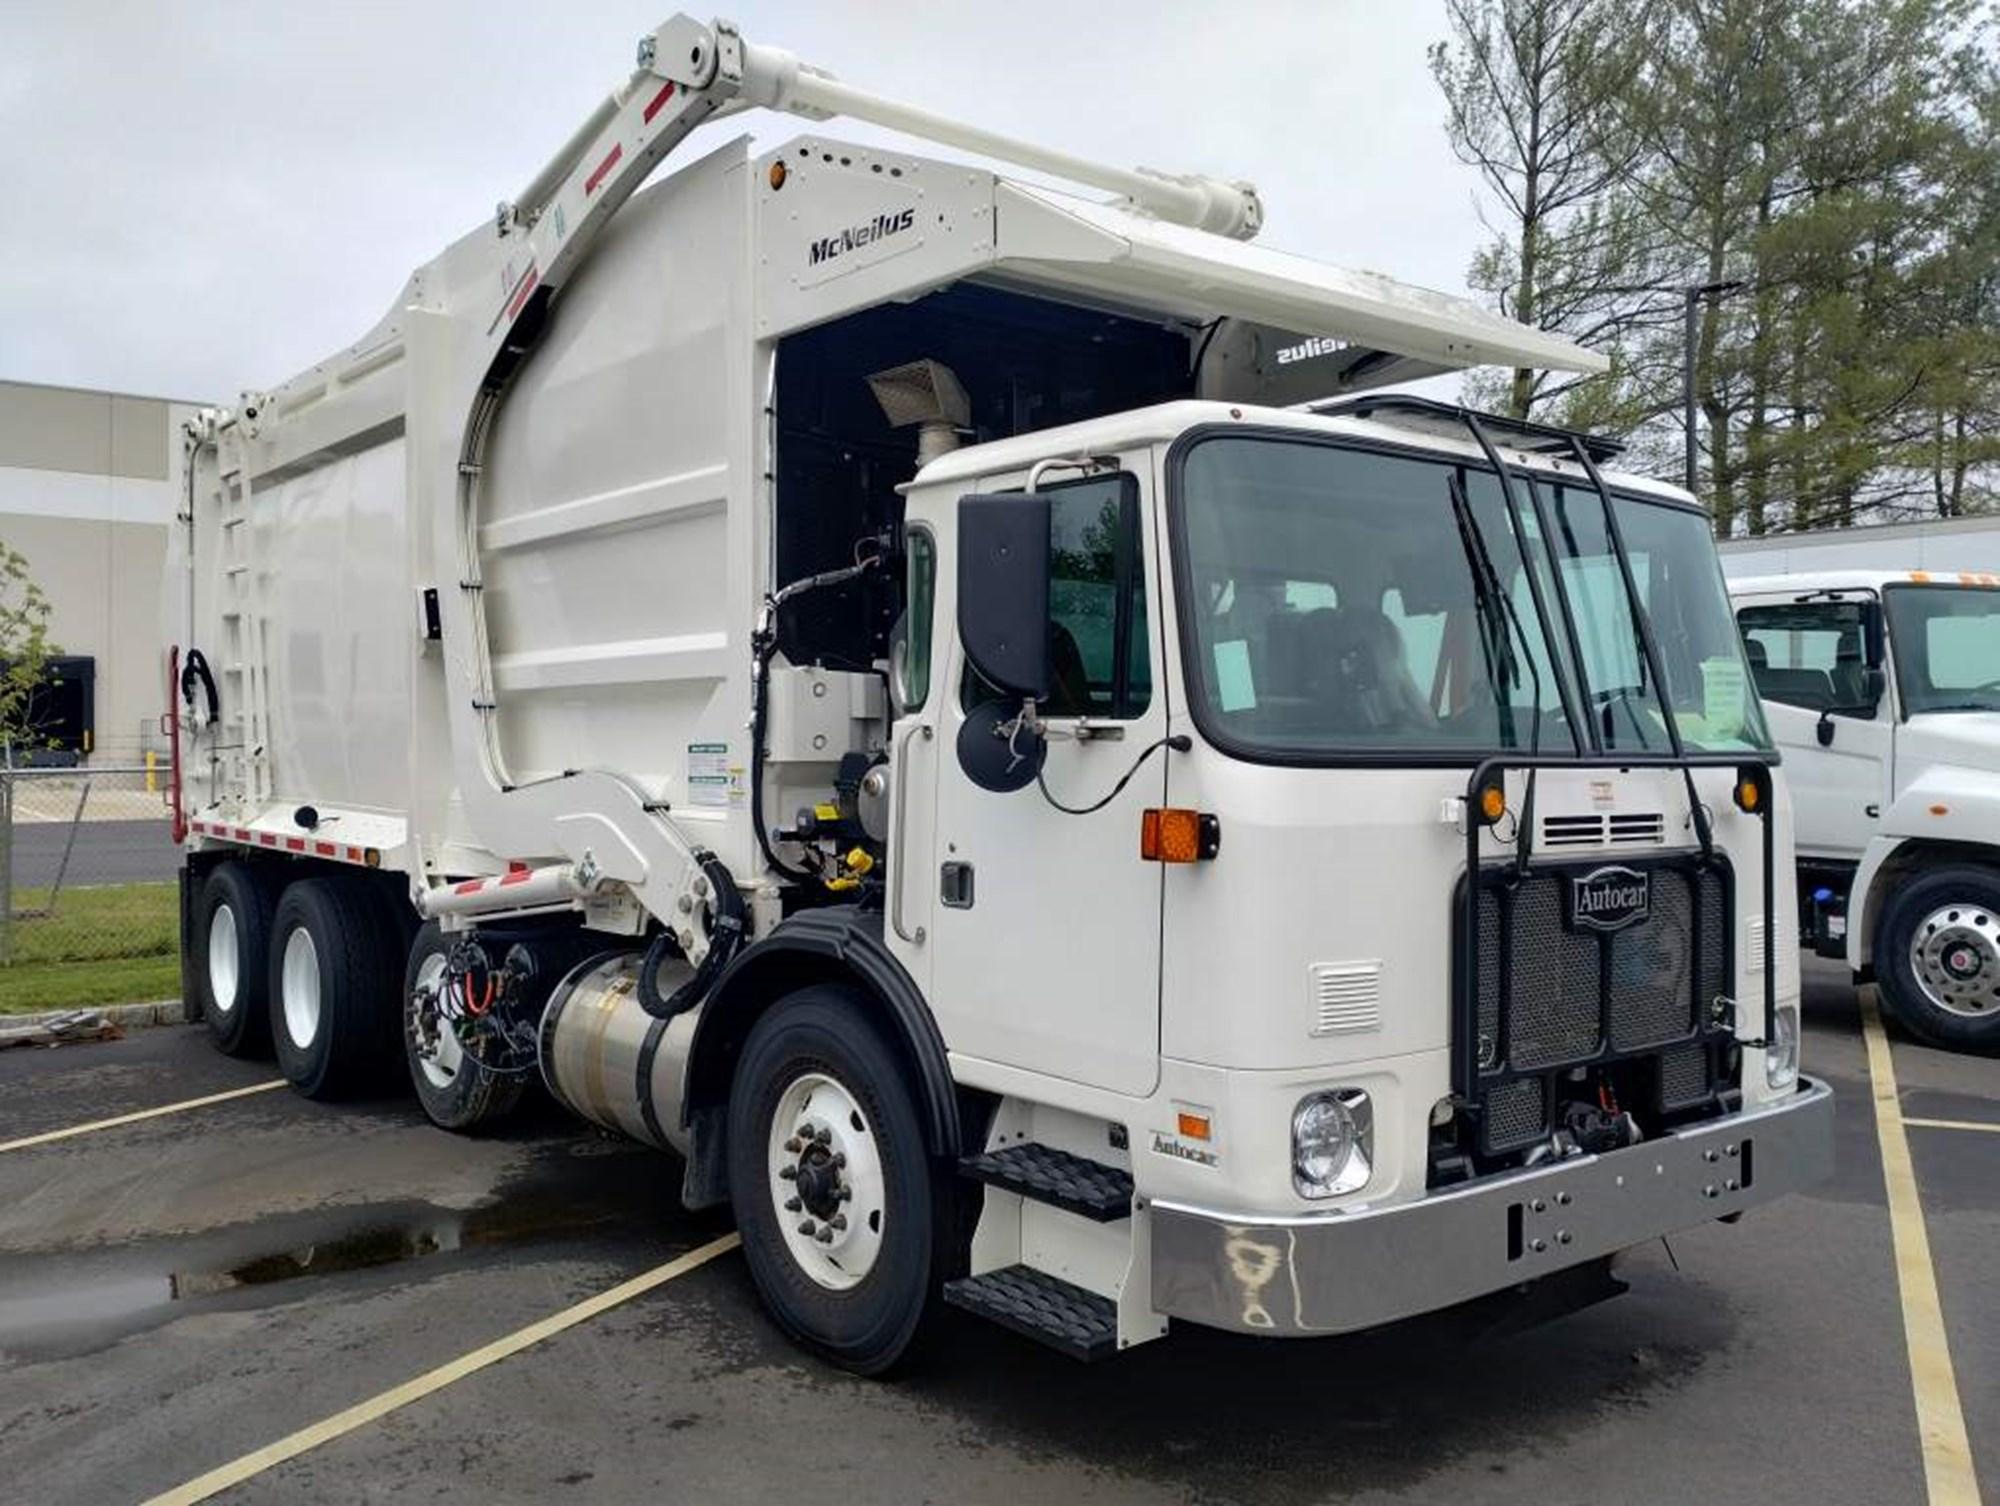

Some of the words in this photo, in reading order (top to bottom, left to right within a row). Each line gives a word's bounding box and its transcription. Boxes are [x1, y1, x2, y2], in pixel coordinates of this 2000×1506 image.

[809, 208, 915, 267] McNeilus
[1579, 884, 1647, 913] Autocar
[1152, 1132, 1219, 1168] Autocar
